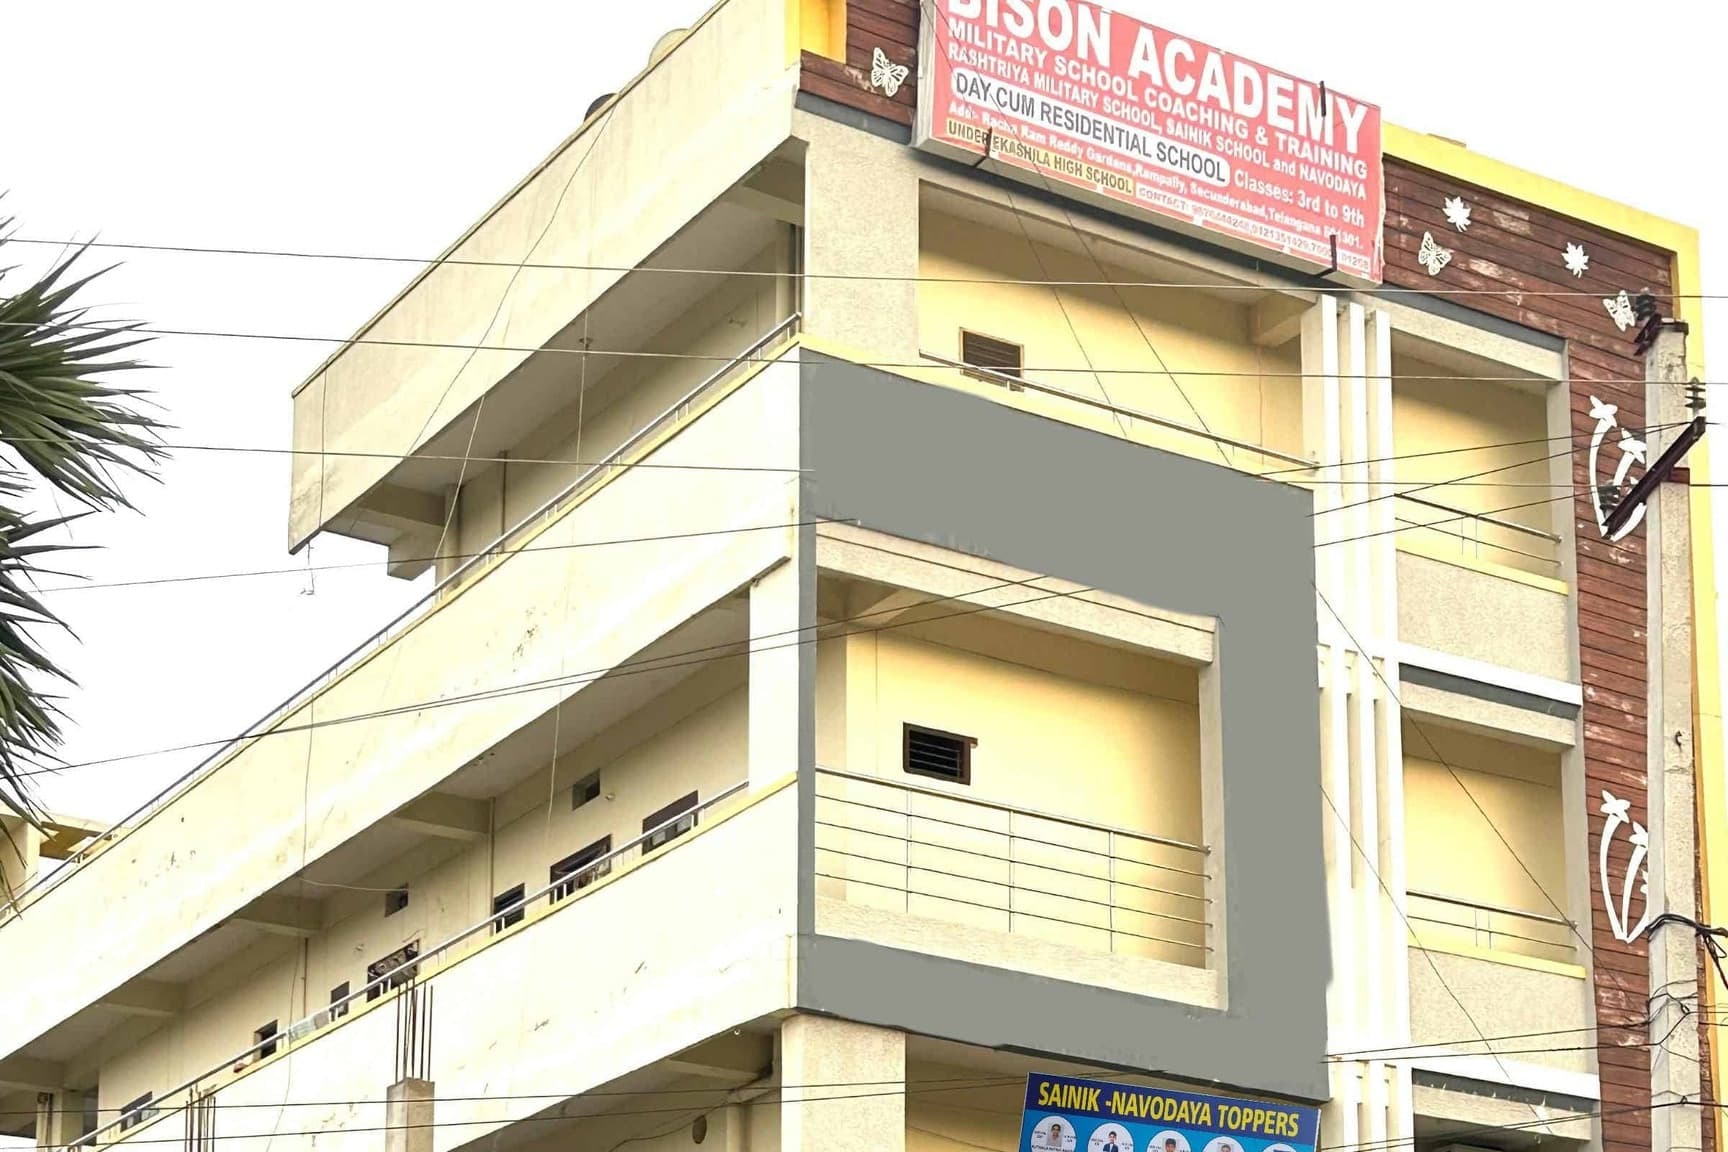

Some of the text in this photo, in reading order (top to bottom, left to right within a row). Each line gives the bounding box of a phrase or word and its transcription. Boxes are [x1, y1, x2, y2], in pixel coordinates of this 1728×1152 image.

[947, 0, 1368, 154] SON ACADEMY
[949, 18, 1368, 179] MILITARY SCHOOL COACHING & TRAINING
[949, 43, 1030, 86] RASHTRIYA
[1034, 72, 1099, 108] MILITARY
[1166, 119, 1213, 149] SAINIK
[1216, 136, 1270, 168] SCHOOL
[1273, 158, 1296, 177] and
[1300, 160, 1367, 200] NAVODAYA
[956, 73, 1226, 182] DAY CUM RESIDENTIAL SCHOOL
[948, 120, 988, 145] UNDER
[1053, 155, 1083, 177] HIGH
[1086, 166, 1132, 193] SCHOOL
[1234, 168, 1365, 228] Classes: 3rd to 9th
[1038, 1081, 1101, 1112] SAINIK
[1218, 1104, 1299, 1137] TOPPERS
